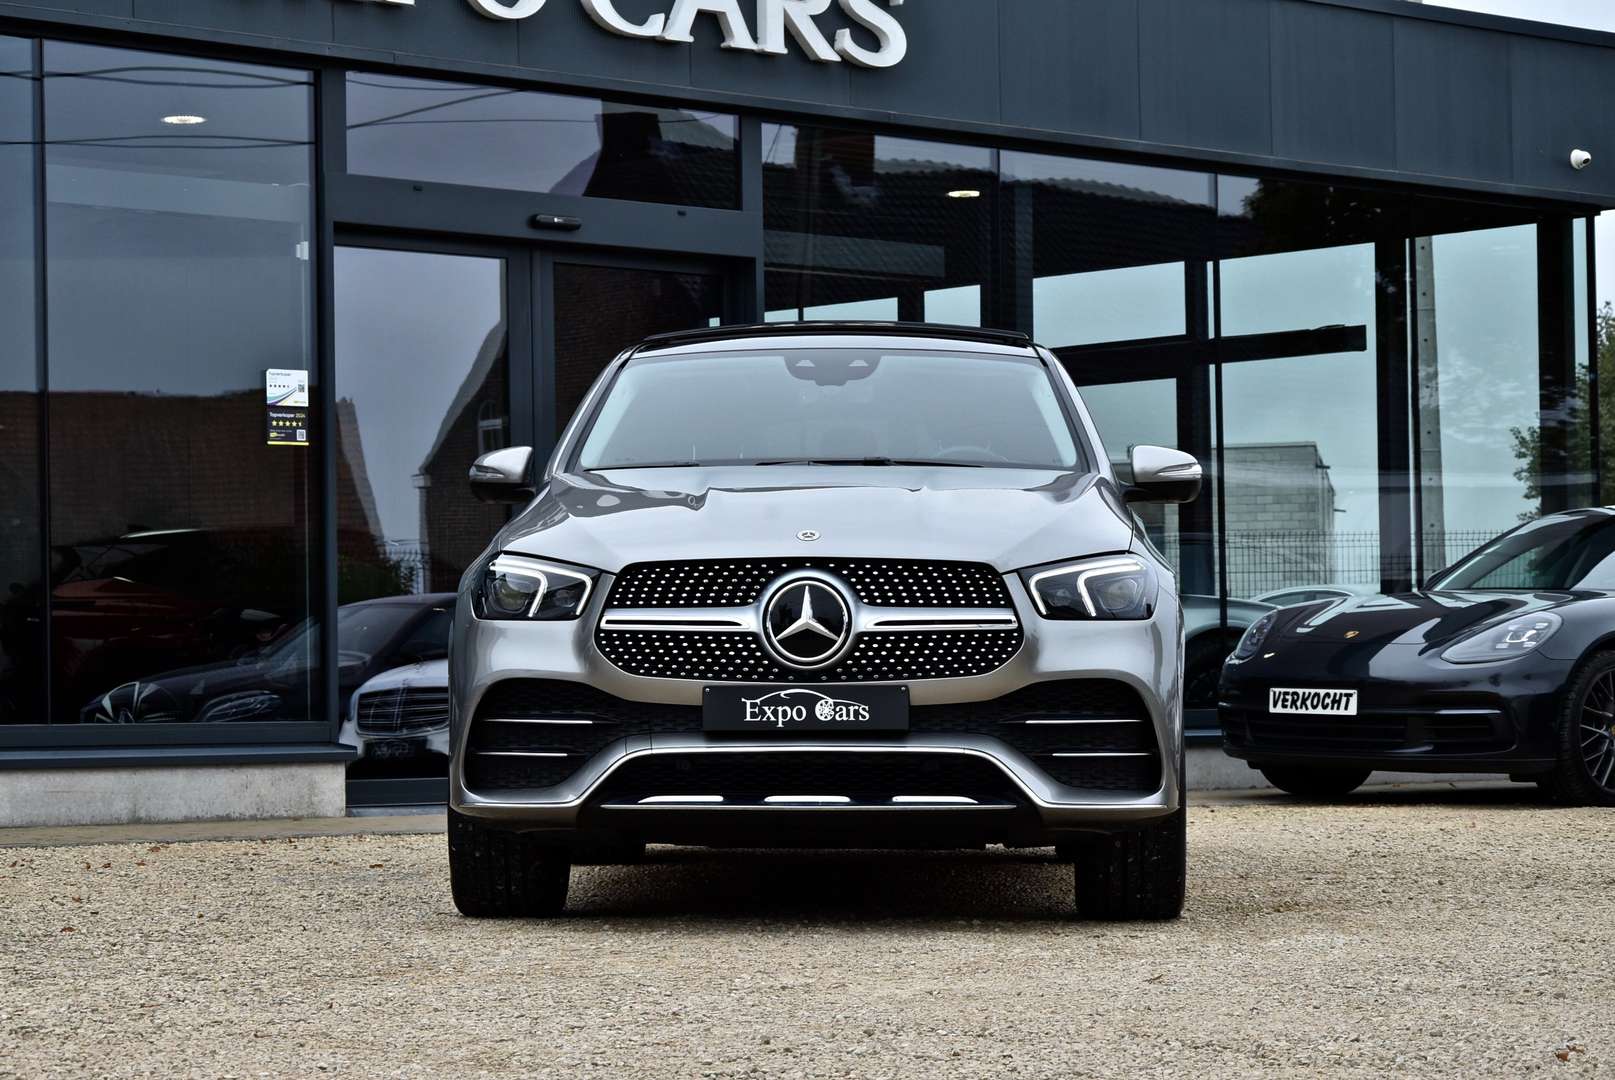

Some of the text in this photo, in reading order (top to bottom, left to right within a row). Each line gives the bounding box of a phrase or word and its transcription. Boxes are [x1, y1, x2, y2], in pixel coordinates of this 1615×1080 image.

[1272, 690, 1354, 711] VERKOCHT
[743, 699, 870, 727] Expo Cars
